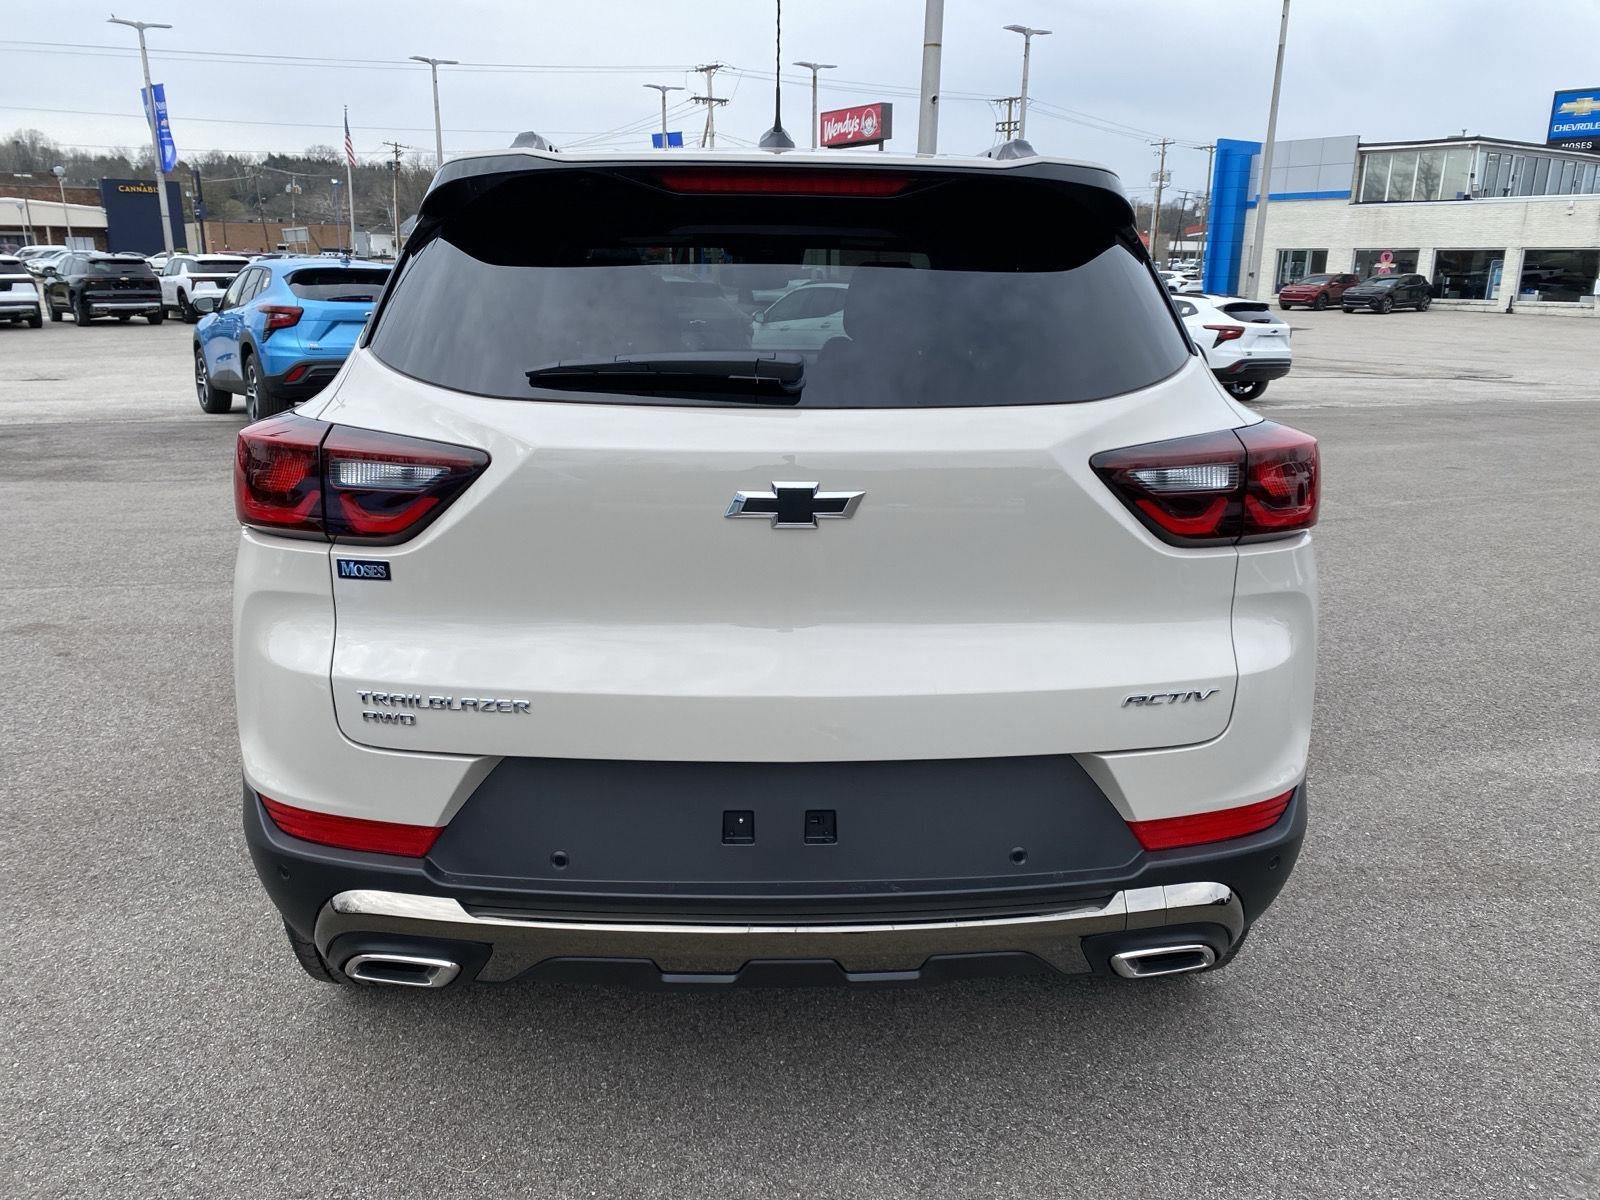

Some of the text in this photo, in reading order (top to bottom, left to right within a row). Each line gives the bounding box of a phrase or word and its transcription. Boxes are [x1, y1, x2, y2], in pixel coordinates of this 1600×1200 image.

[824, 112, 859, 142] Wendy's
[1561, 141, 1592, 149] MOSES
[356, 690, 531, 714] TRAILBLAZER
[1121, 687, 1220, 708] ACTIV
[362, 710, 416, 726] AWD
